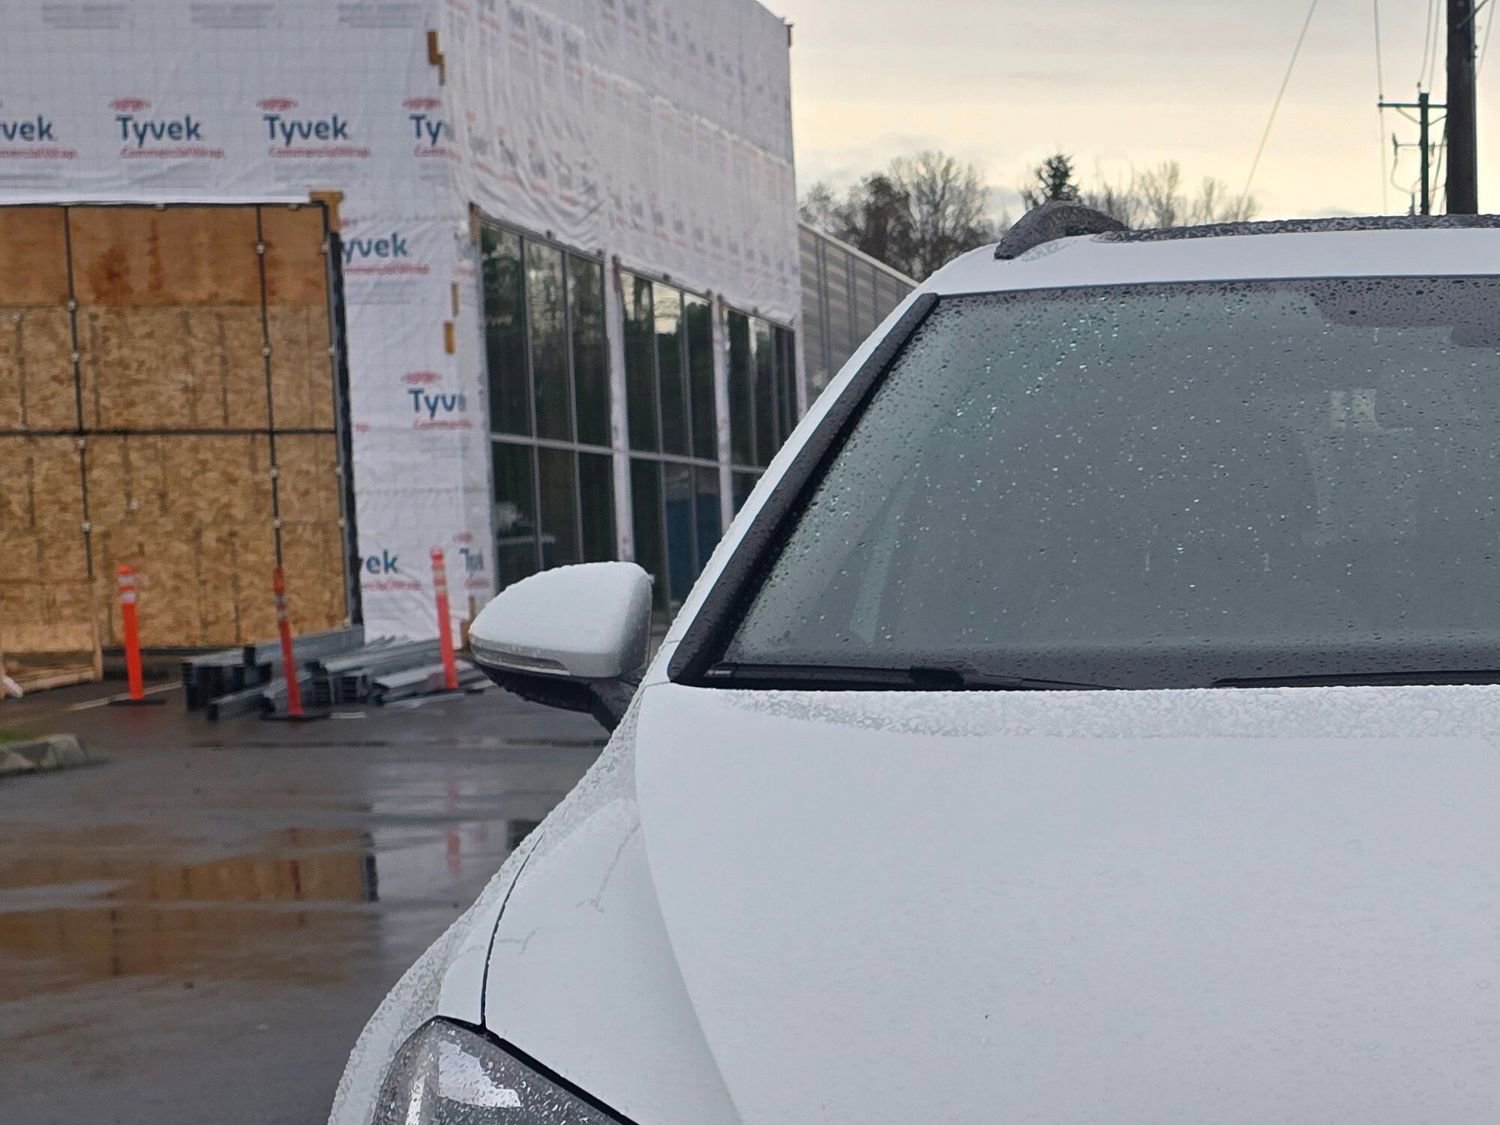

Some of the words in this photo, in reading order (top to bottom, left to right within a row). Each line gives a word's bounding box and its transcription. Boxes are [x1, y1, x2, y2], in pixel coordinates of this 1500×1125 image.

[0, 113, 53, 141] vek
[115, 113, 201, 148] Tyvek
[263, 113, 348, 147] Tyvek
[409, 112, 453, 147] Ty
[360, 548, 398, 575] ek
